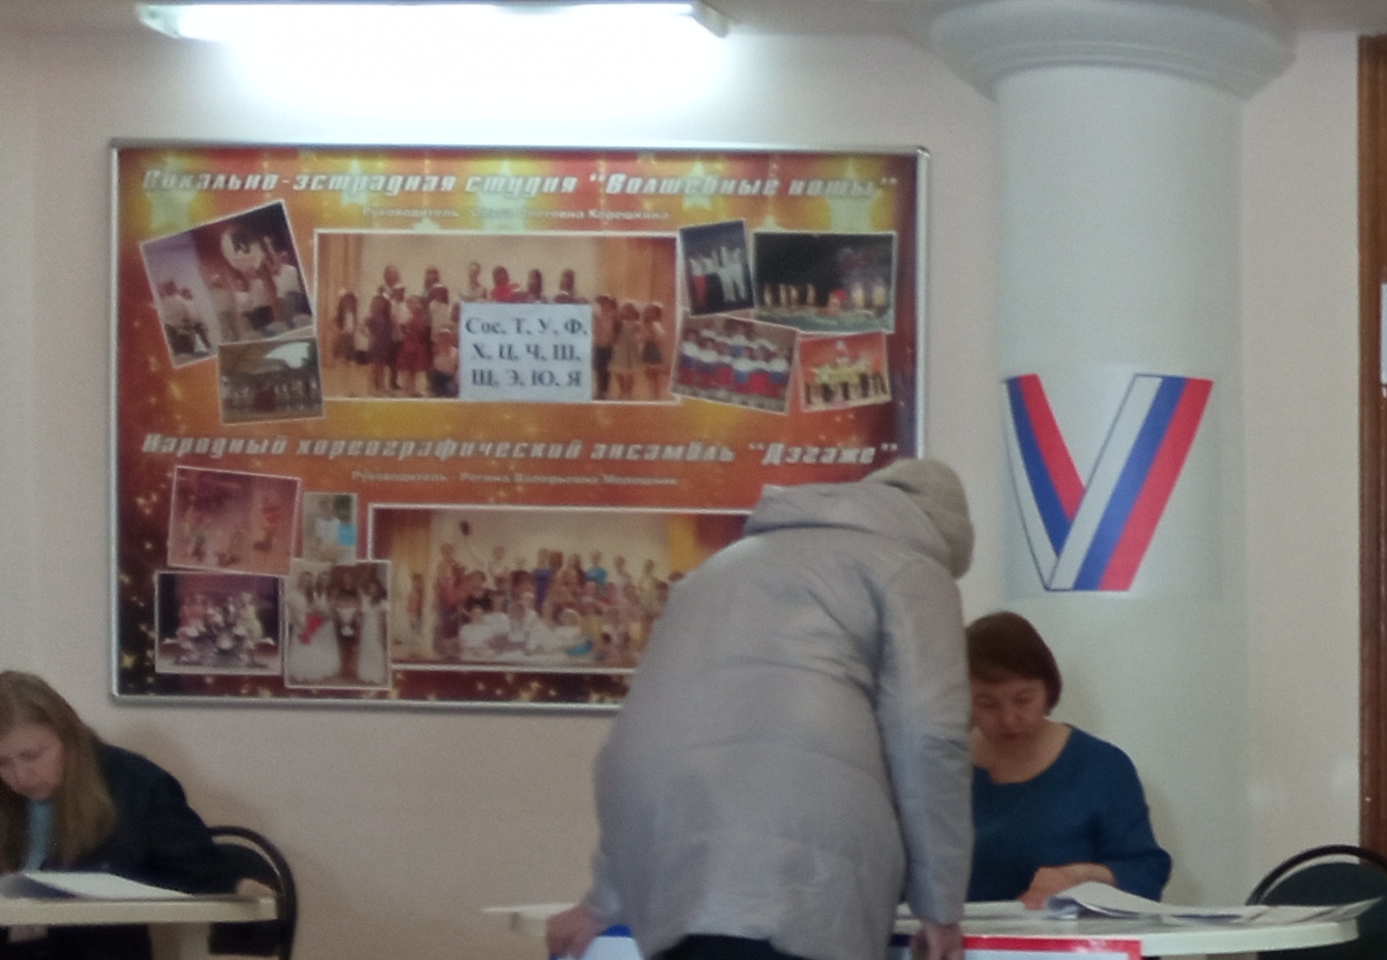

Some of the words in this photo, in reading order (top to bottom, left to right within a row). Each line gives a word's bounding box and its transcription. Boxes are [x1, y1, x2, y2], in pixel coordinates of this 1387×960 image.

[465, 173, 578, 199] студия
[465, 316, 507, 335] Сос,
[512, 317, 532, 335] Т,
[538, 317, 559, 335] У,
[563, 318, 590, 335] Ф,
[525, 343, 547, 361] Ч,
[504, 369, 525, 387] Э,
[531, 369, 560, 387] Ю,
[567, 370, 582, 387] Я
[142, 432, 289, 458] Народный
[296, 436, 583, 461] хореографический
[590, 440, 735, 462] ансамбль
